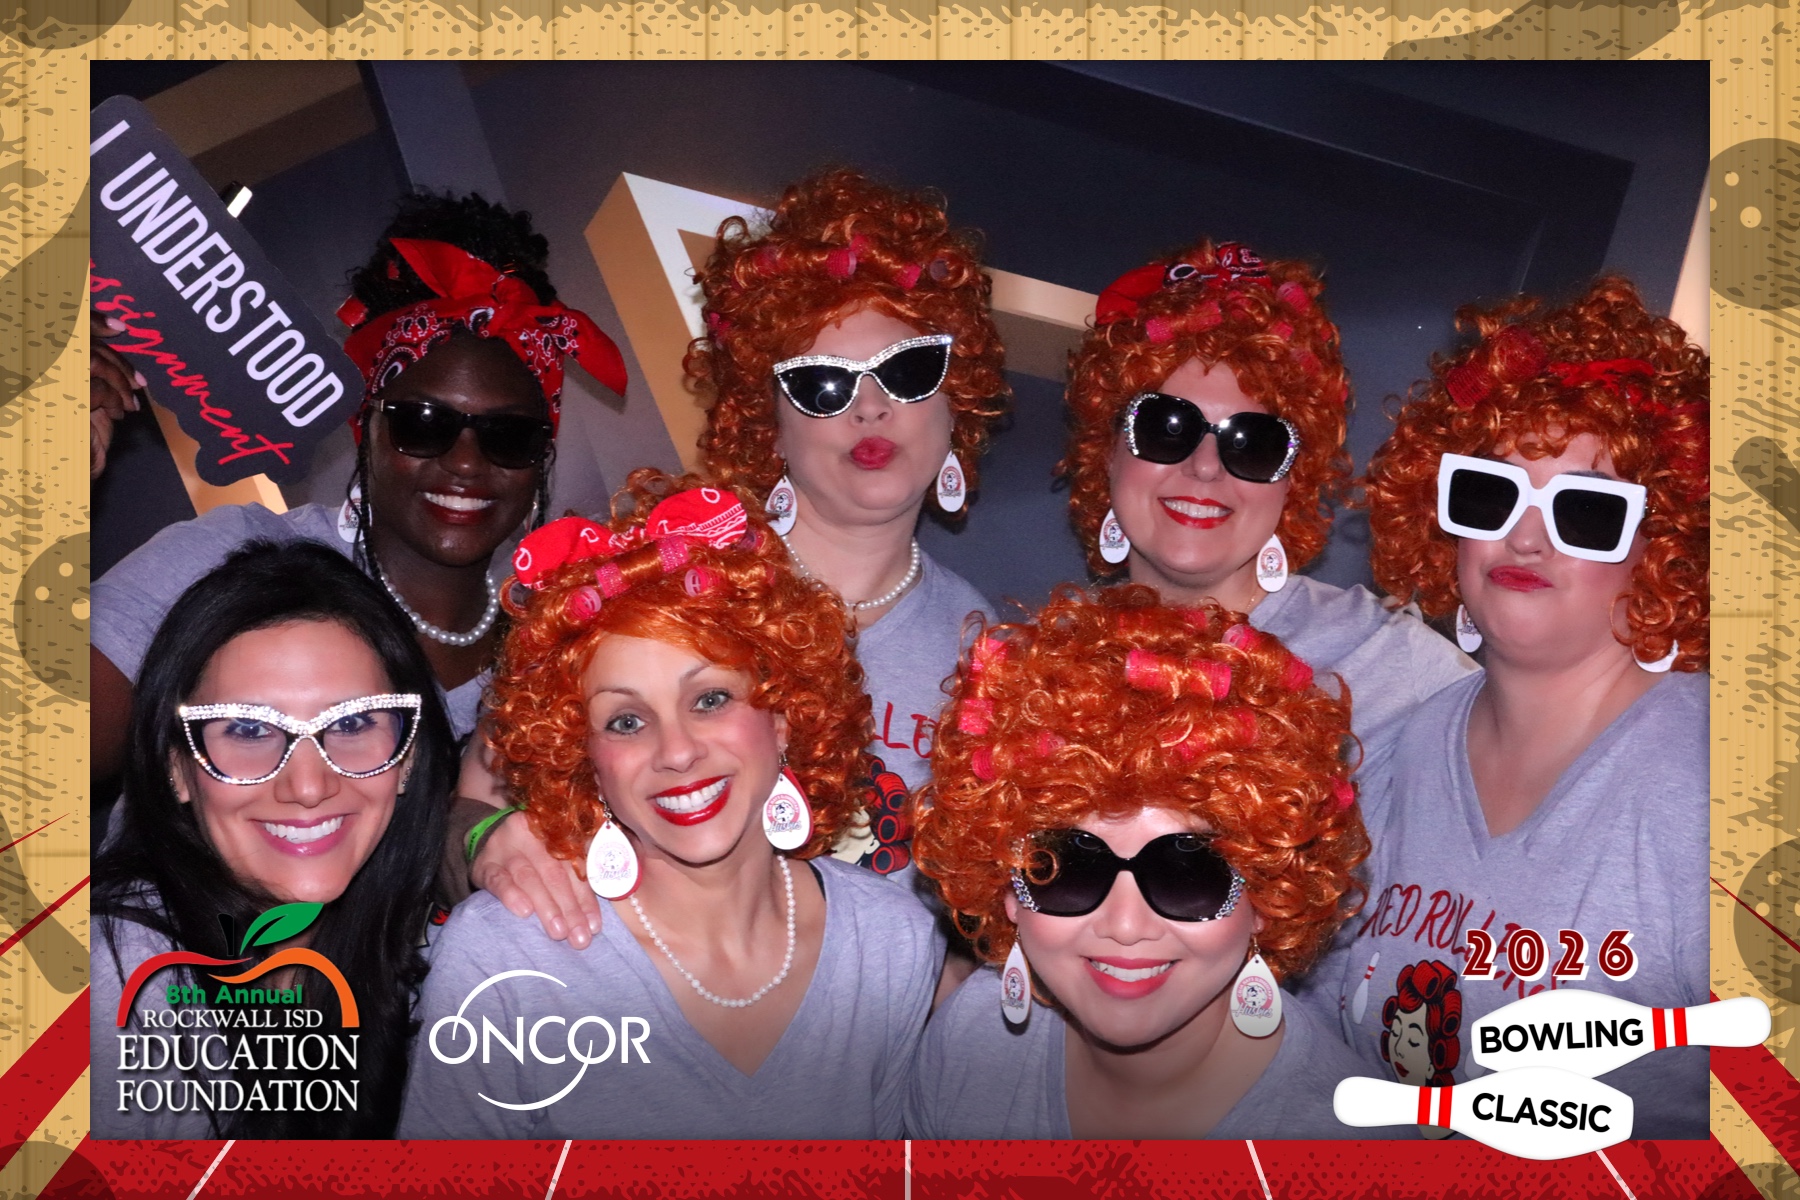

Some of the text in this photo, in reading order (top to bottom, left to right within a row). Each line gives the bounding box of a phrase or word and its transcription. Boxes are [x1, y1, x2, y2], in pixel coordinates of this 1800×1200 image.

[90, 120, 344, 427] I UNDERSTOOD
[90, 258, 294, 465] ssignment
